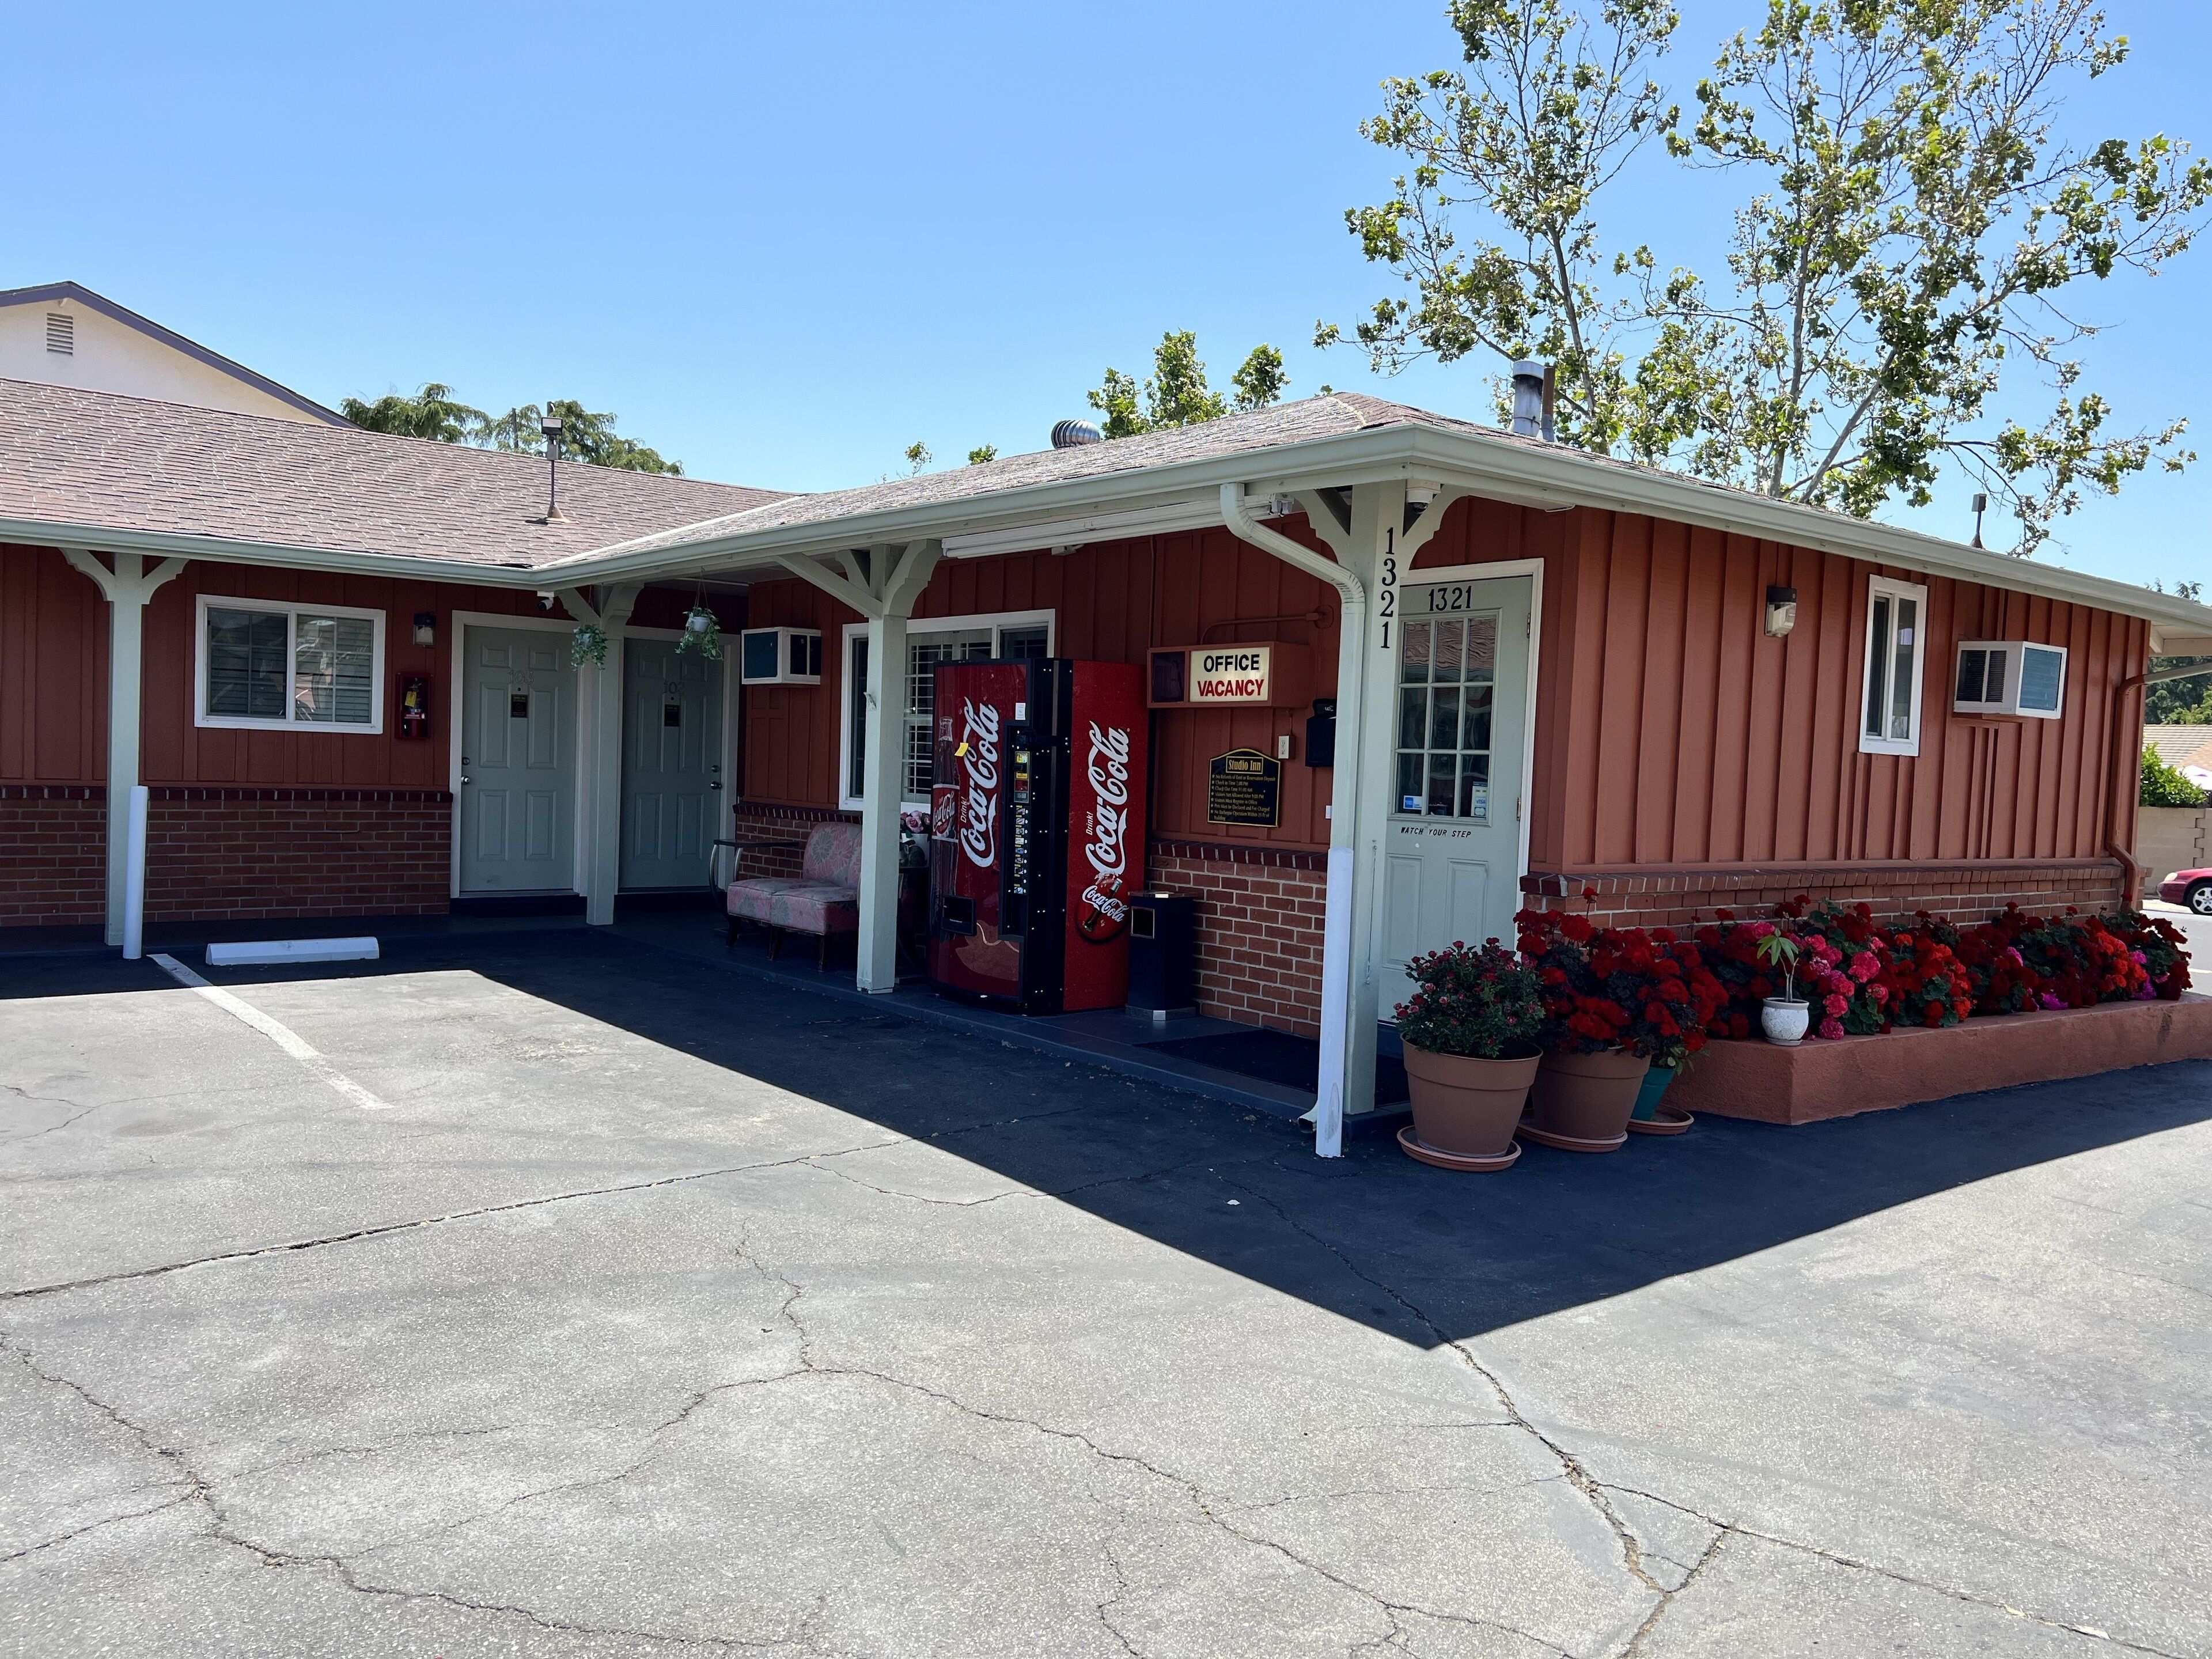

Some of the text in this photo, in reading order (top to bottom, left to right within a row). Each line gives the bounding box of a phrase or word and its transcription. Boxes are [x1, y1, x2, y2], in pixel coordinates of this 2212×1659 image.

[1380, 527, 1396, 649] 1321
[1429, 585, 1472, 612] 1321
[508, 669, 535, 684] 103
[1203, 654, 1260, 672] OFFICE
[1197, 679, 1264, 696] VACANCY
[1229, 759, 1261, 771] Studio Inn
[960, 696, 999, 868] Coca-Cola
[960, 796, 968, 823] Drink!
[1085, 721, 1129, 875] Coca-Cola
[1429, 828, 1447, 836] YOUR
[1082, 885, 1130, 922] Coca-Cola
